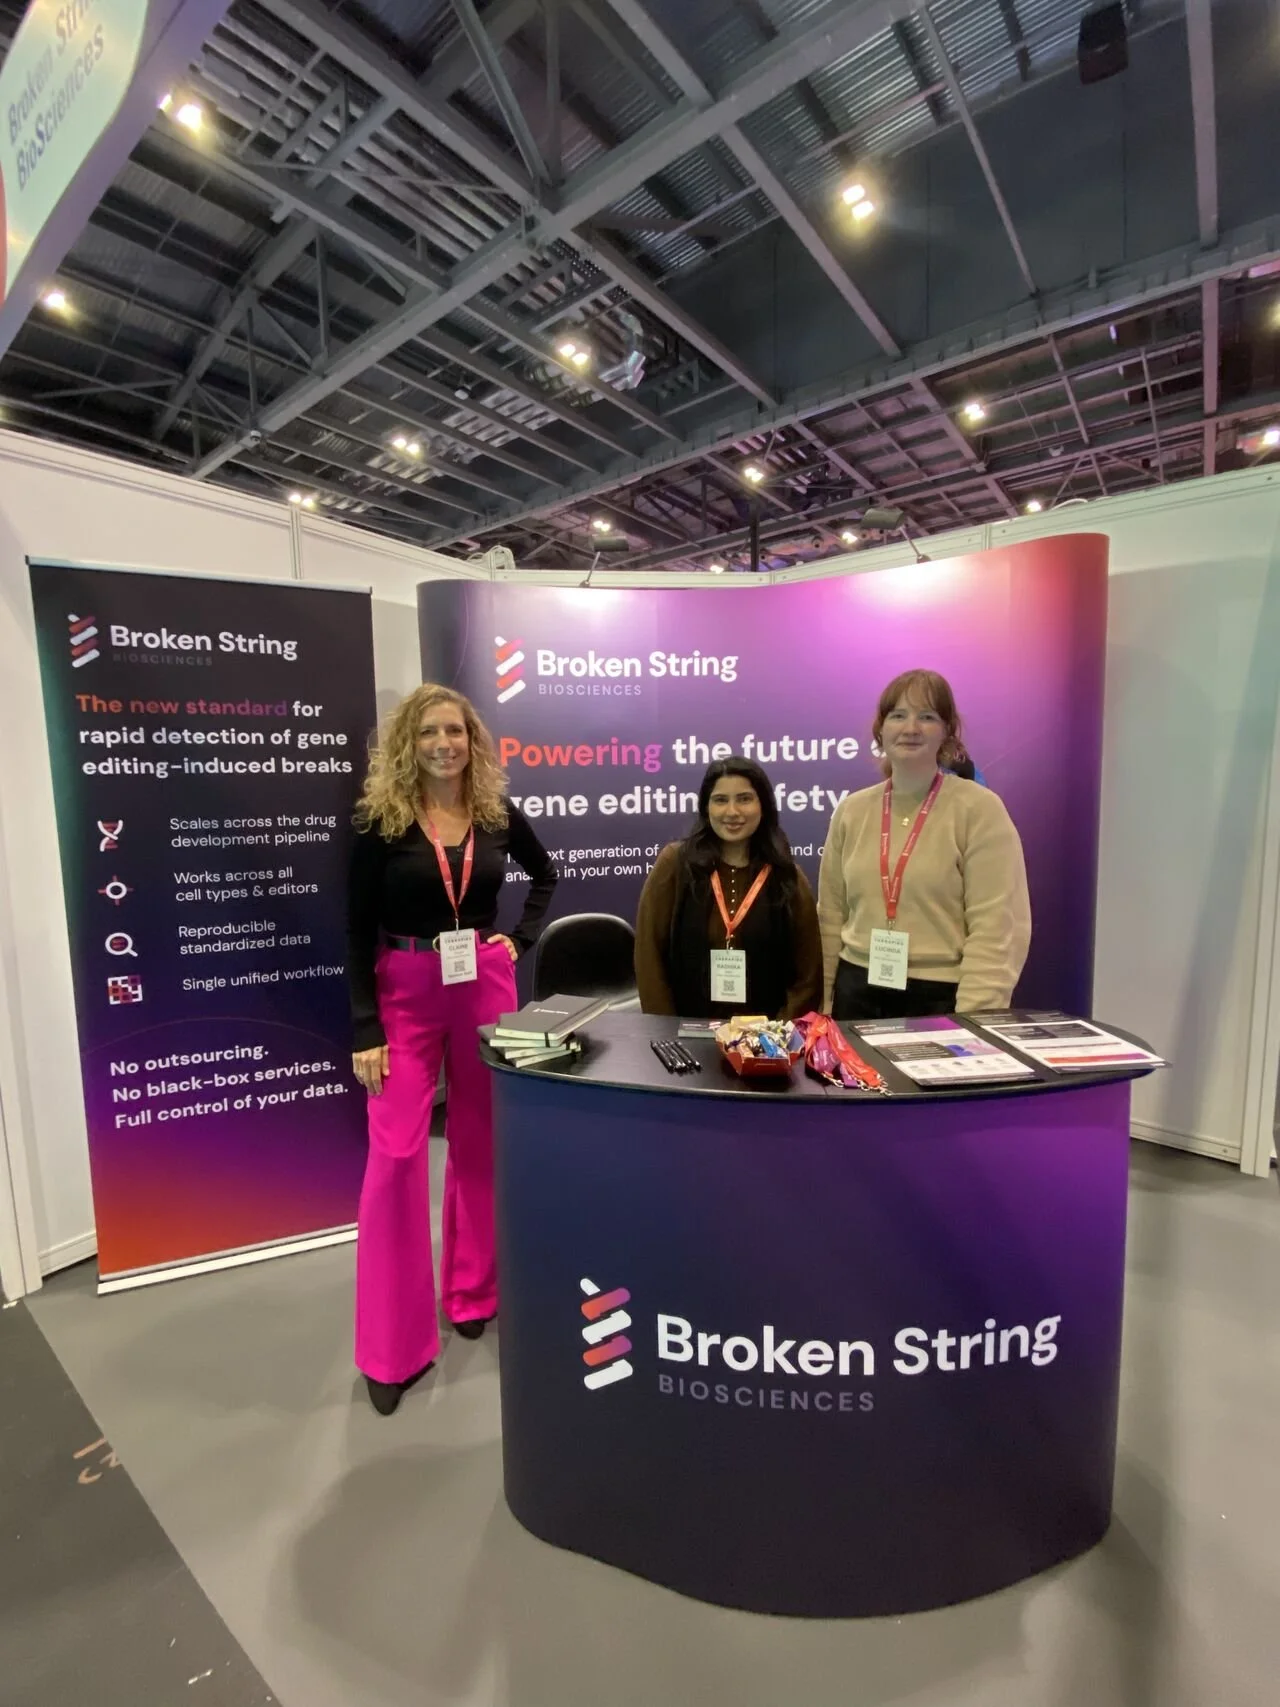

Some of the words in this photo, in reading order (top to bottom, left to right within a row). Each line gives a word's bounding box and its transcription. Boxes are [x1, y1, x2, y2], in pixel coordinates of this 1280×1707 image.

[7, 44, 53, 146] Broken
[16, 23, 104, 192] BioSciences
[110, 624, 212, 651] Broken
[218, 631, 298, 661] String
[112, 653, 213, 666] BIOSCIENCES
[536, 649, 642, 677] Broken
[649, 650, 738, 682] String
[538, 683, 642, 696] BIOSCIENCES
[75, 694, 122, 714] The
[130, 700, 180, 715] new
[186, 699, 287, 716] standard
[292, 701, 323, 717] for
[79, 726, 145, 748] rapid
[152, 727, 264, 745] detection
[270, 729, 292, 745] of
[297, 732, 348, 749] gene
[500, 737, 662, 773] Powering
[671, 735, 732, 765] the
[741, 733, 859, 762] future
[82, 756, 276, 779] editing-induced
[281, 757, 353, 774] breaks
[598, 785, 698, 815] editin
[169, 818, 219, 830] Scales
[223, 817, 273, 829] across
[276, 815, 301, 827] the
[304, 814, 337, 828] drug
[171, 833, 270, 849] development
[274, 831, 330, 847] pipeline
[568, 844, 641, 863] generation
[645, 844, 659, 857] of
[174, 871, 221, 884] Works
[225, 869, 274, 882] across
[278, 867, 293, 879] all
[564, 865, 576, 878] in
[579, 865, 610, 880] your
[613, 864, 642, 876] own
[175, 889, 202, 902] cell
[205, 887, 249, 903] types
[252, 886, 264, 897] &
[268, 882, 319, 896] editors
[178, 920, 276, 938] Reproducible
[180, 935, 275, 955] standardized
[279, 933, 311, 947] data
[182, 976, 226, 992] Single
[230, 971, 280, 987] unified
[283, 964, 345, 981] workflow
[110, 1061, 139, 1076] No
[144, 1045, 269, 1070] outsourcing.
[112, 1088, 142, 1103] No
[147, 1073, 249, 1097] black-box
[254, 1060, 337, 1082] services.
[115, 1110, 151, 1129] Full
[157, 1097, 229, 1121] control
[233, 1094, 253, 1110] of
[256, 1090, 299, 1109] your
[302, 1081, 349, 1099] data.
[657, 1313, 875, 1376] Broken
[892, 1314, 1062, 1377] String
[658, 1373, 876, 1412] BIOSCIENCES
